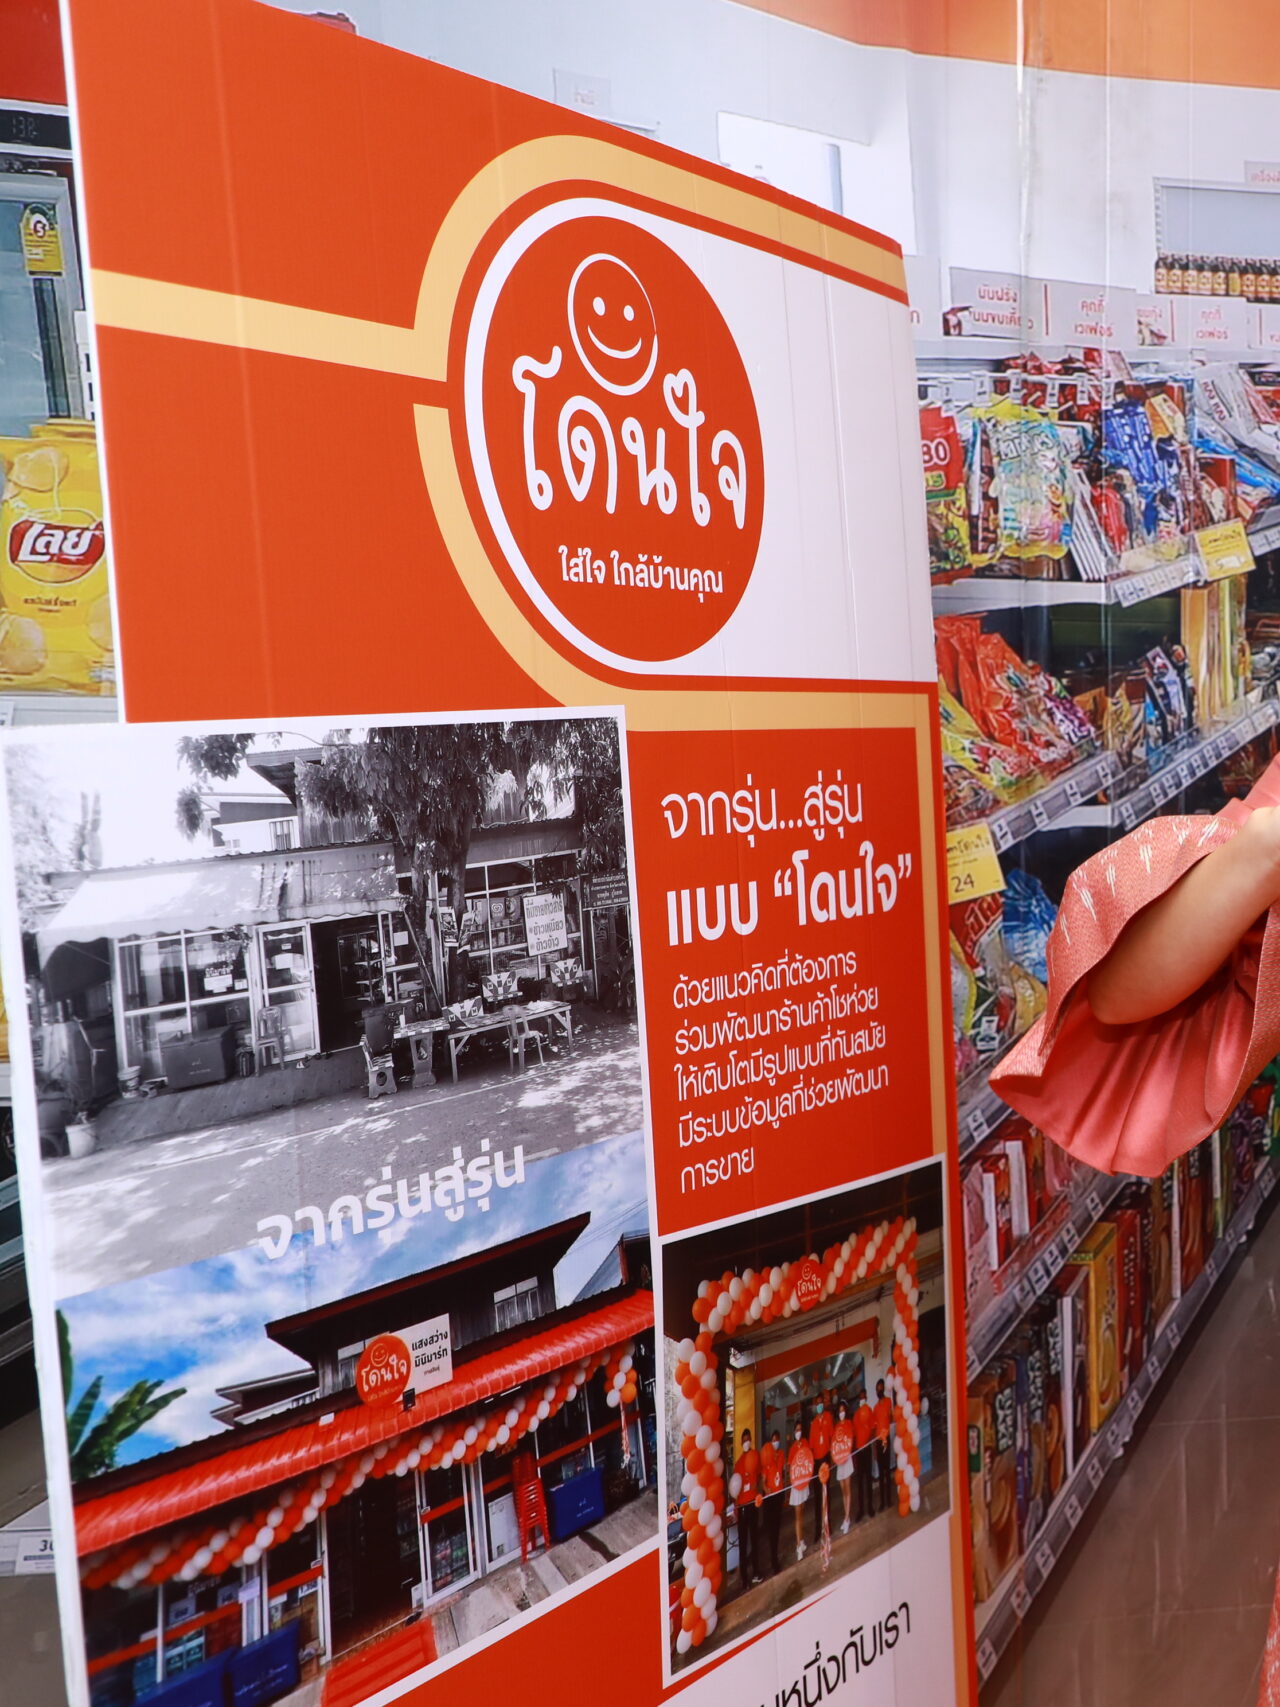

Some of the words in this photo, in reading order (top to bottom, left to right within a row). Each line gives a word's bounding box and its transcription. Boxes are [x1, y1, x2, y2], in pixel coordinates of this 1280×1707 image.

[512, 345, 748, 530] โดนใจ
[558, 545, 606, 584] ใส่ใจ
[610, 550, 724, 603] ใกล้บ้านคุณ
[661, 770, 863, 847] จากรุ่น...สู่รุ่น
[667, 878, 760, 946] แบบ
[773, 841, 913, 926] “โดนใจ”
[951, 873, 975, 893] 24
[673, 949, 858, 1009] ด้วยแนวคิดที่ต้องการ
[674, 984, 879, 1056] ร่วมพัฒนาร้านค้าโชห่วย
[674, 1022, 887, 1101] ให้เติบโตมีรูปแบบที่ทันสมัย
[678, 1063, 889, 1148] มีระบบข้อมูลที่ช่วยพัฒนา
[256, 1138, 526, 1260] จากรุ่นสู่รุ่น
[681, 1147, 755, 1194] การขาย
[361, 1354, 407, 1392] โดนใจ
[411, 1329, 448, 1351] แสงสว่าง
[414, 1345, 448, 1368] มินิมาร์ท
[760, 1601, 911, 1707] หนึ่งกับเรา
